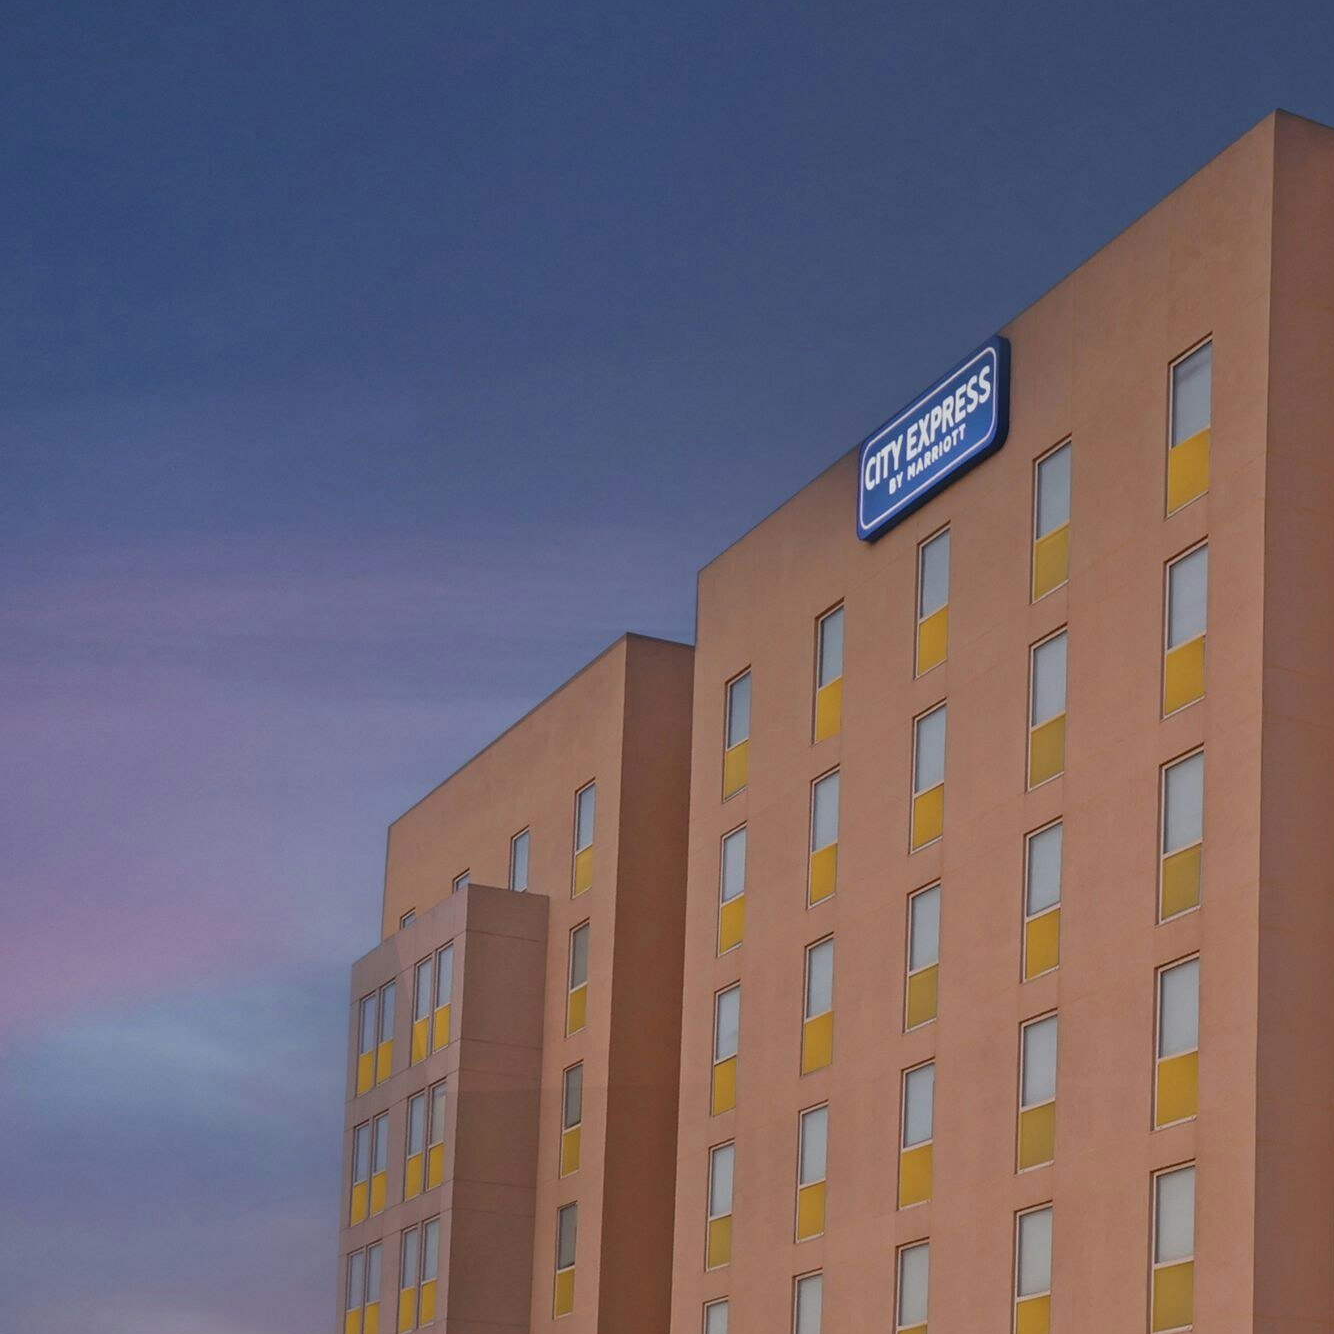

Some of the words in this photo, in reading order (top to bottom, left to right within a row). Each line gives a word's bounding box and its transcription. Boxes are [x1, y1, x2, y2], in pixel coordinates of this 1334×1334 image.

[865, 434, 904, 491] CITY
[906, 365, 991, 461] EXPRESS
[888, 472, 904, 495] BY
[907, 424, 966, 481] MARRIOTT
